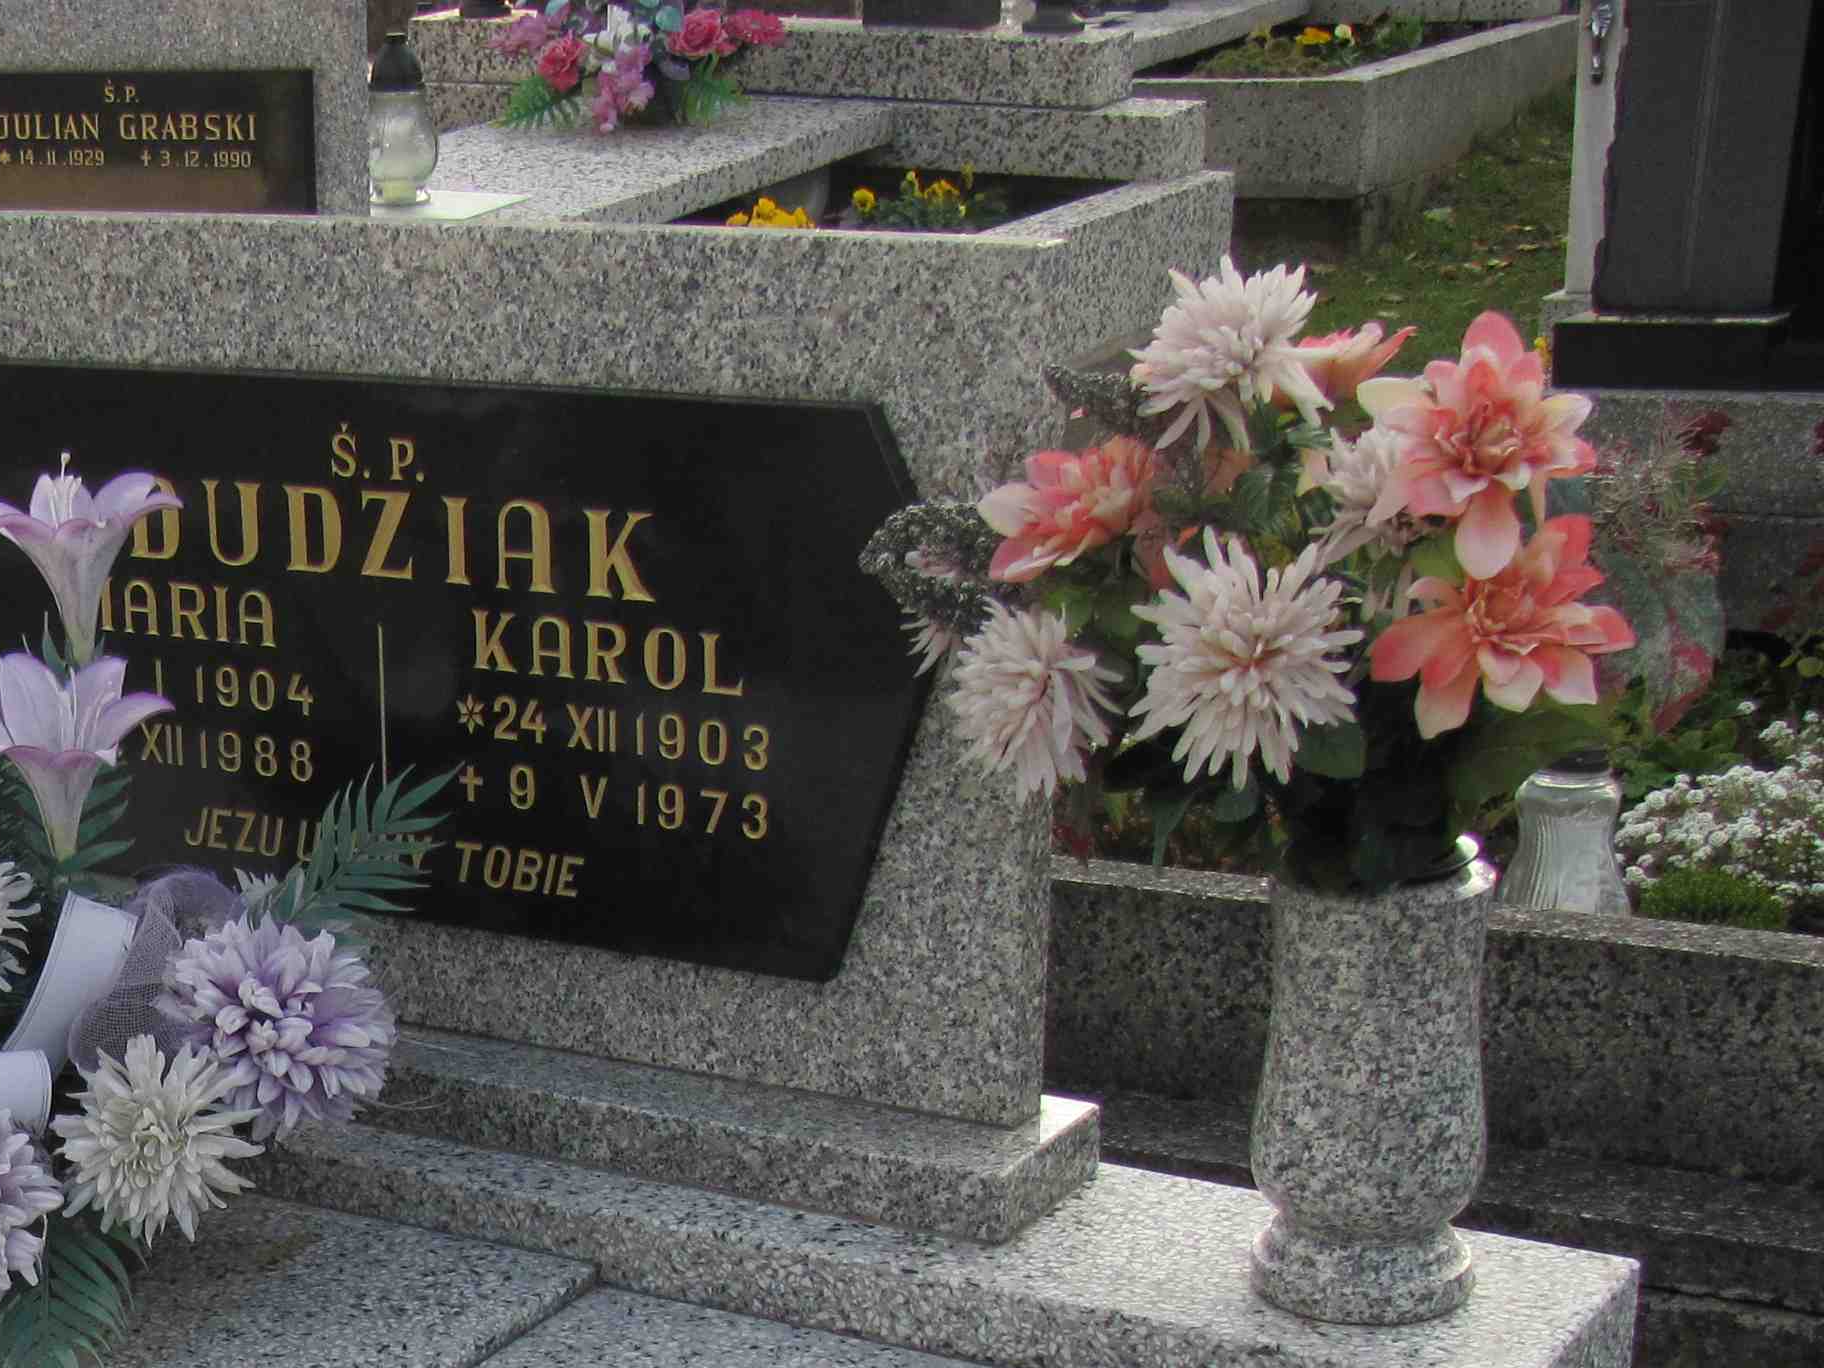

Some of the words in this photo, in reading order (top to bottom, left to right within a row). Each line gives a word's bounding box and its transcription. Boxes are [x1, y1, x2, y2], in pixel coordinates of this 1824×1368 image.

[119, 112, 258, 141] GRABSKI
[129, 476, 658, 603] DUDZIAK
[98, 576, 277, 649] ARIA
[471, 607, 745, 697] KAROL
[195, 664, 315, 717] 1904
[140, 721, 185, 767] XII
[199, 729, 315, 781] 1988
[565, 701, 618, 753] XII
[633, 710, 771, 771] 1903
[508, 763, 537, 811] 9
[579, 774, 609, 819] V
[637, 782, 770, 840] 1973
[184, 807, 285, 857] JEZU
[454, 840, 587, 898] TOBIE
